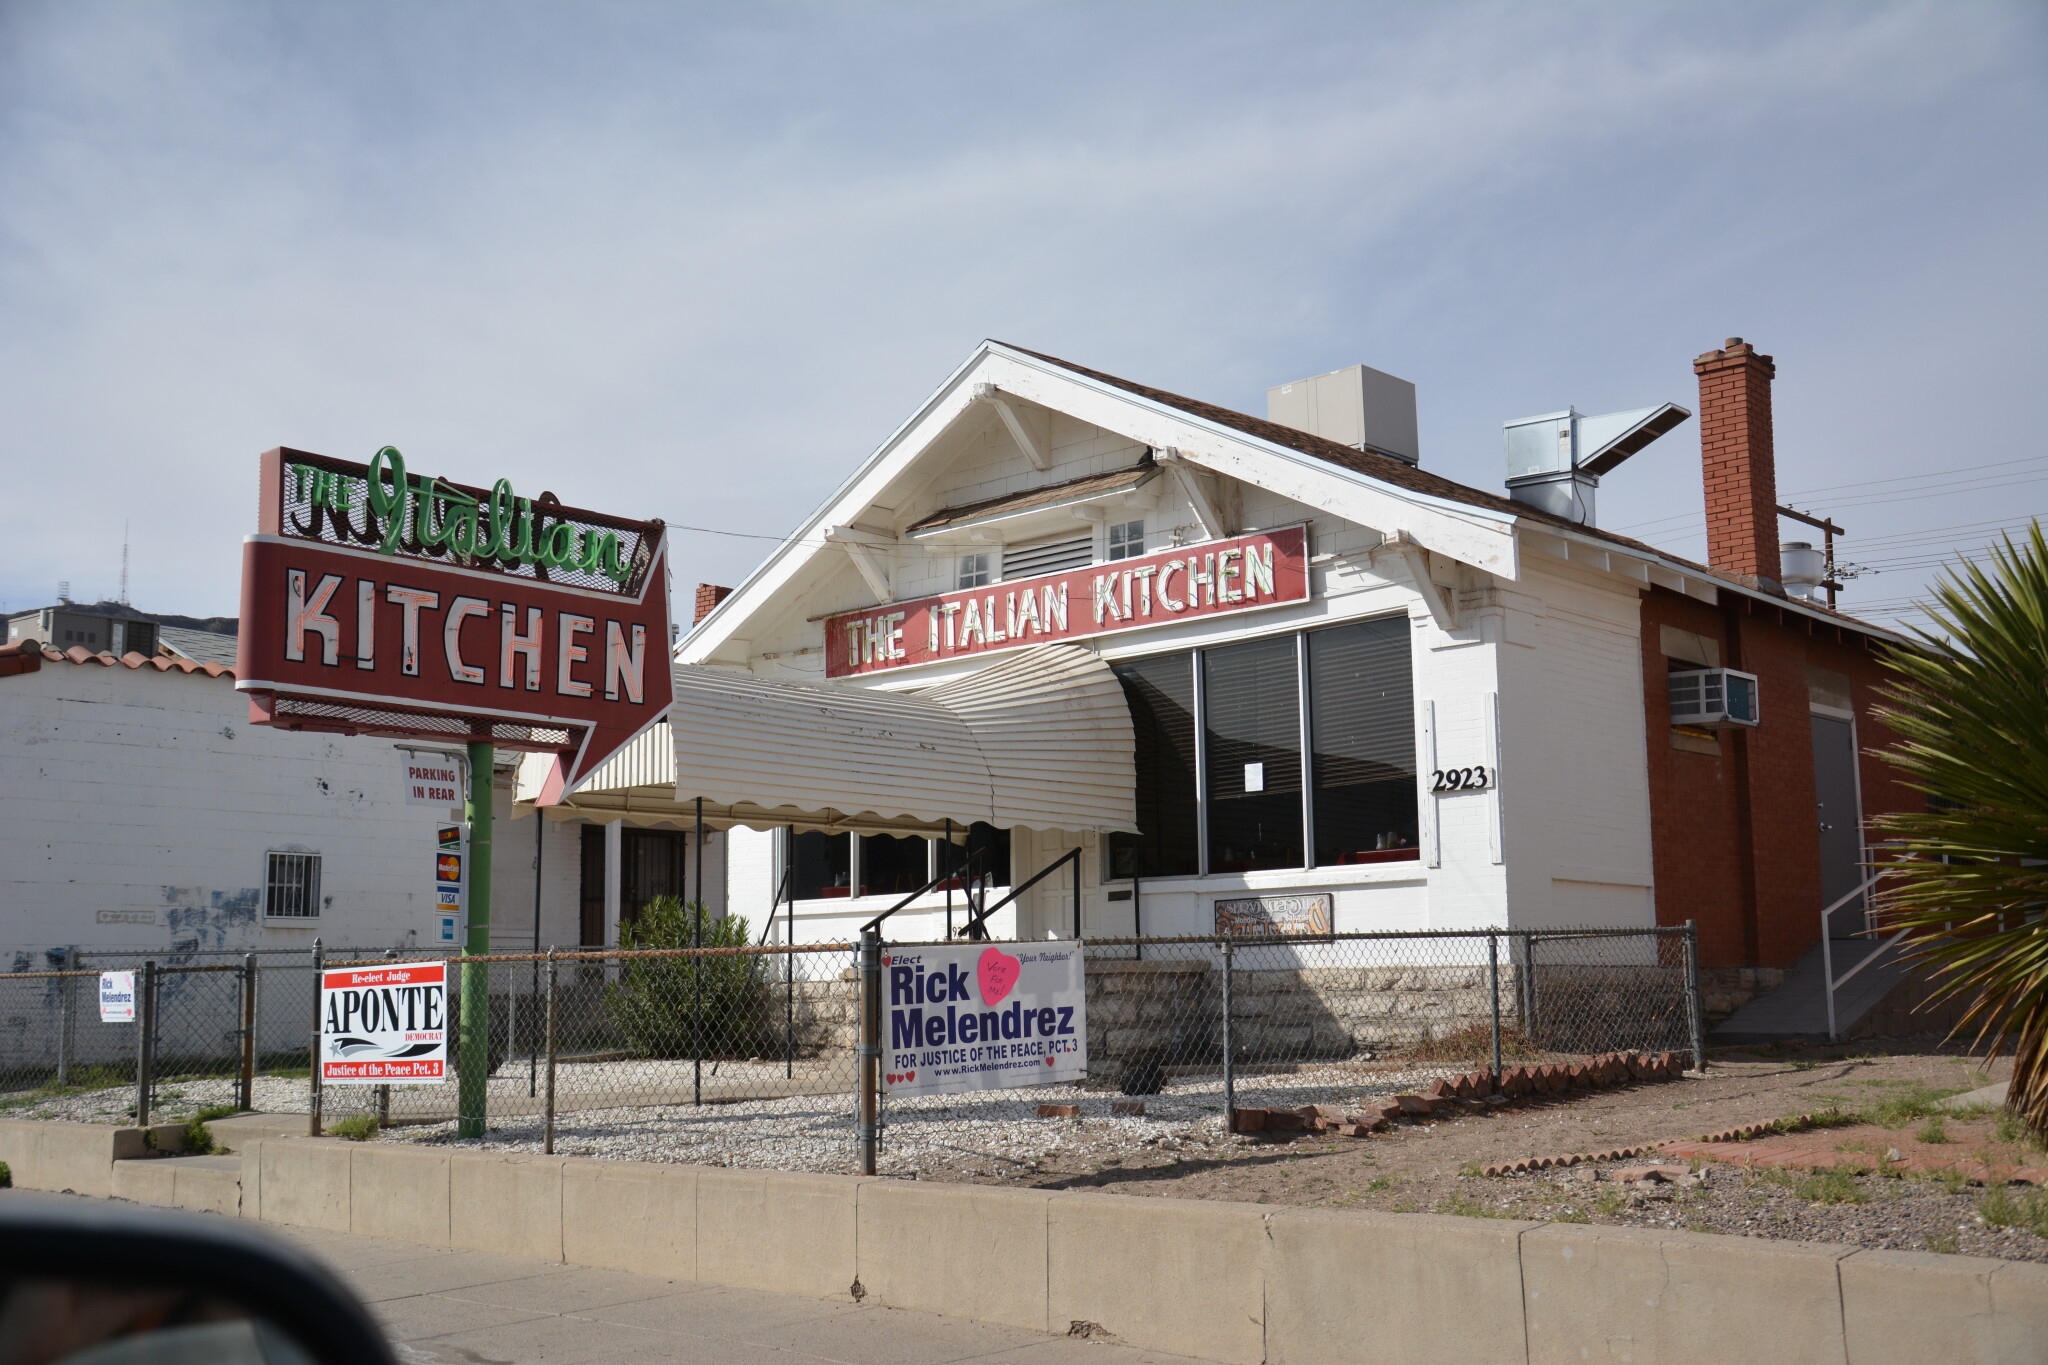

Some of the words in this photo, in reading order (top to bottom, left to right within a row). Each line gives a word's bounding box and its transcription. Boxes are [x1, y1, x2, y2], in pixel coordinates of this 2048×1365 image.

[291, 464, 359, 512] THE
[367, 446, 633, 582] Italian
[845, 611, 905, 667] THE
[928, 581, 1068, 652] ITALIAN
[1094, 542, 1275, 624] KITCHEN
[285, 567, 647, 705] KITCHEN
[409, 766, 456, 782] PARKING
[1432, 765, 1488, 792] 2923
[412, 785, 425, 799] IN
[428, 787, 455, 801] REAR
[441, 893, 456, 904] VISA
[890, 954, 922, 965] Elect
[351, 972, 383, 984] Re-elect
[386, 971, 411, 984] Judge
[890, 963, 970, 1006] Rick
[102, 990, 132, 1003] Melendrez
[324, 985, 444, 1034] APONTE
[891, 1000, 1075, 1050] Melendrez
[405, 1032, 444, 1042] DEMOCRAT
[895, 1054, 918, 1070] FOR
[920, 1048, 967, 1067] JUSTICE
[969, 1047, 984, 1062] OF
[985, 1045, 1008, 1060] THE
[1010, 1041, 1047, 1058] PEACE,
[1072, 1038, 1078, 1052] 3
[327, 1064, 357, 1076] Justice
[358, 1063, 367, 1075] of
[368, 1063, 383, 1075] the
[384, 1063, 411, 1075] Peace
[413, 1062, 431, 1075] Pct.
[433, 1062, 439, 1074] 3
[934, 1058, 1041, 1077] www.RickMelendrez.com
